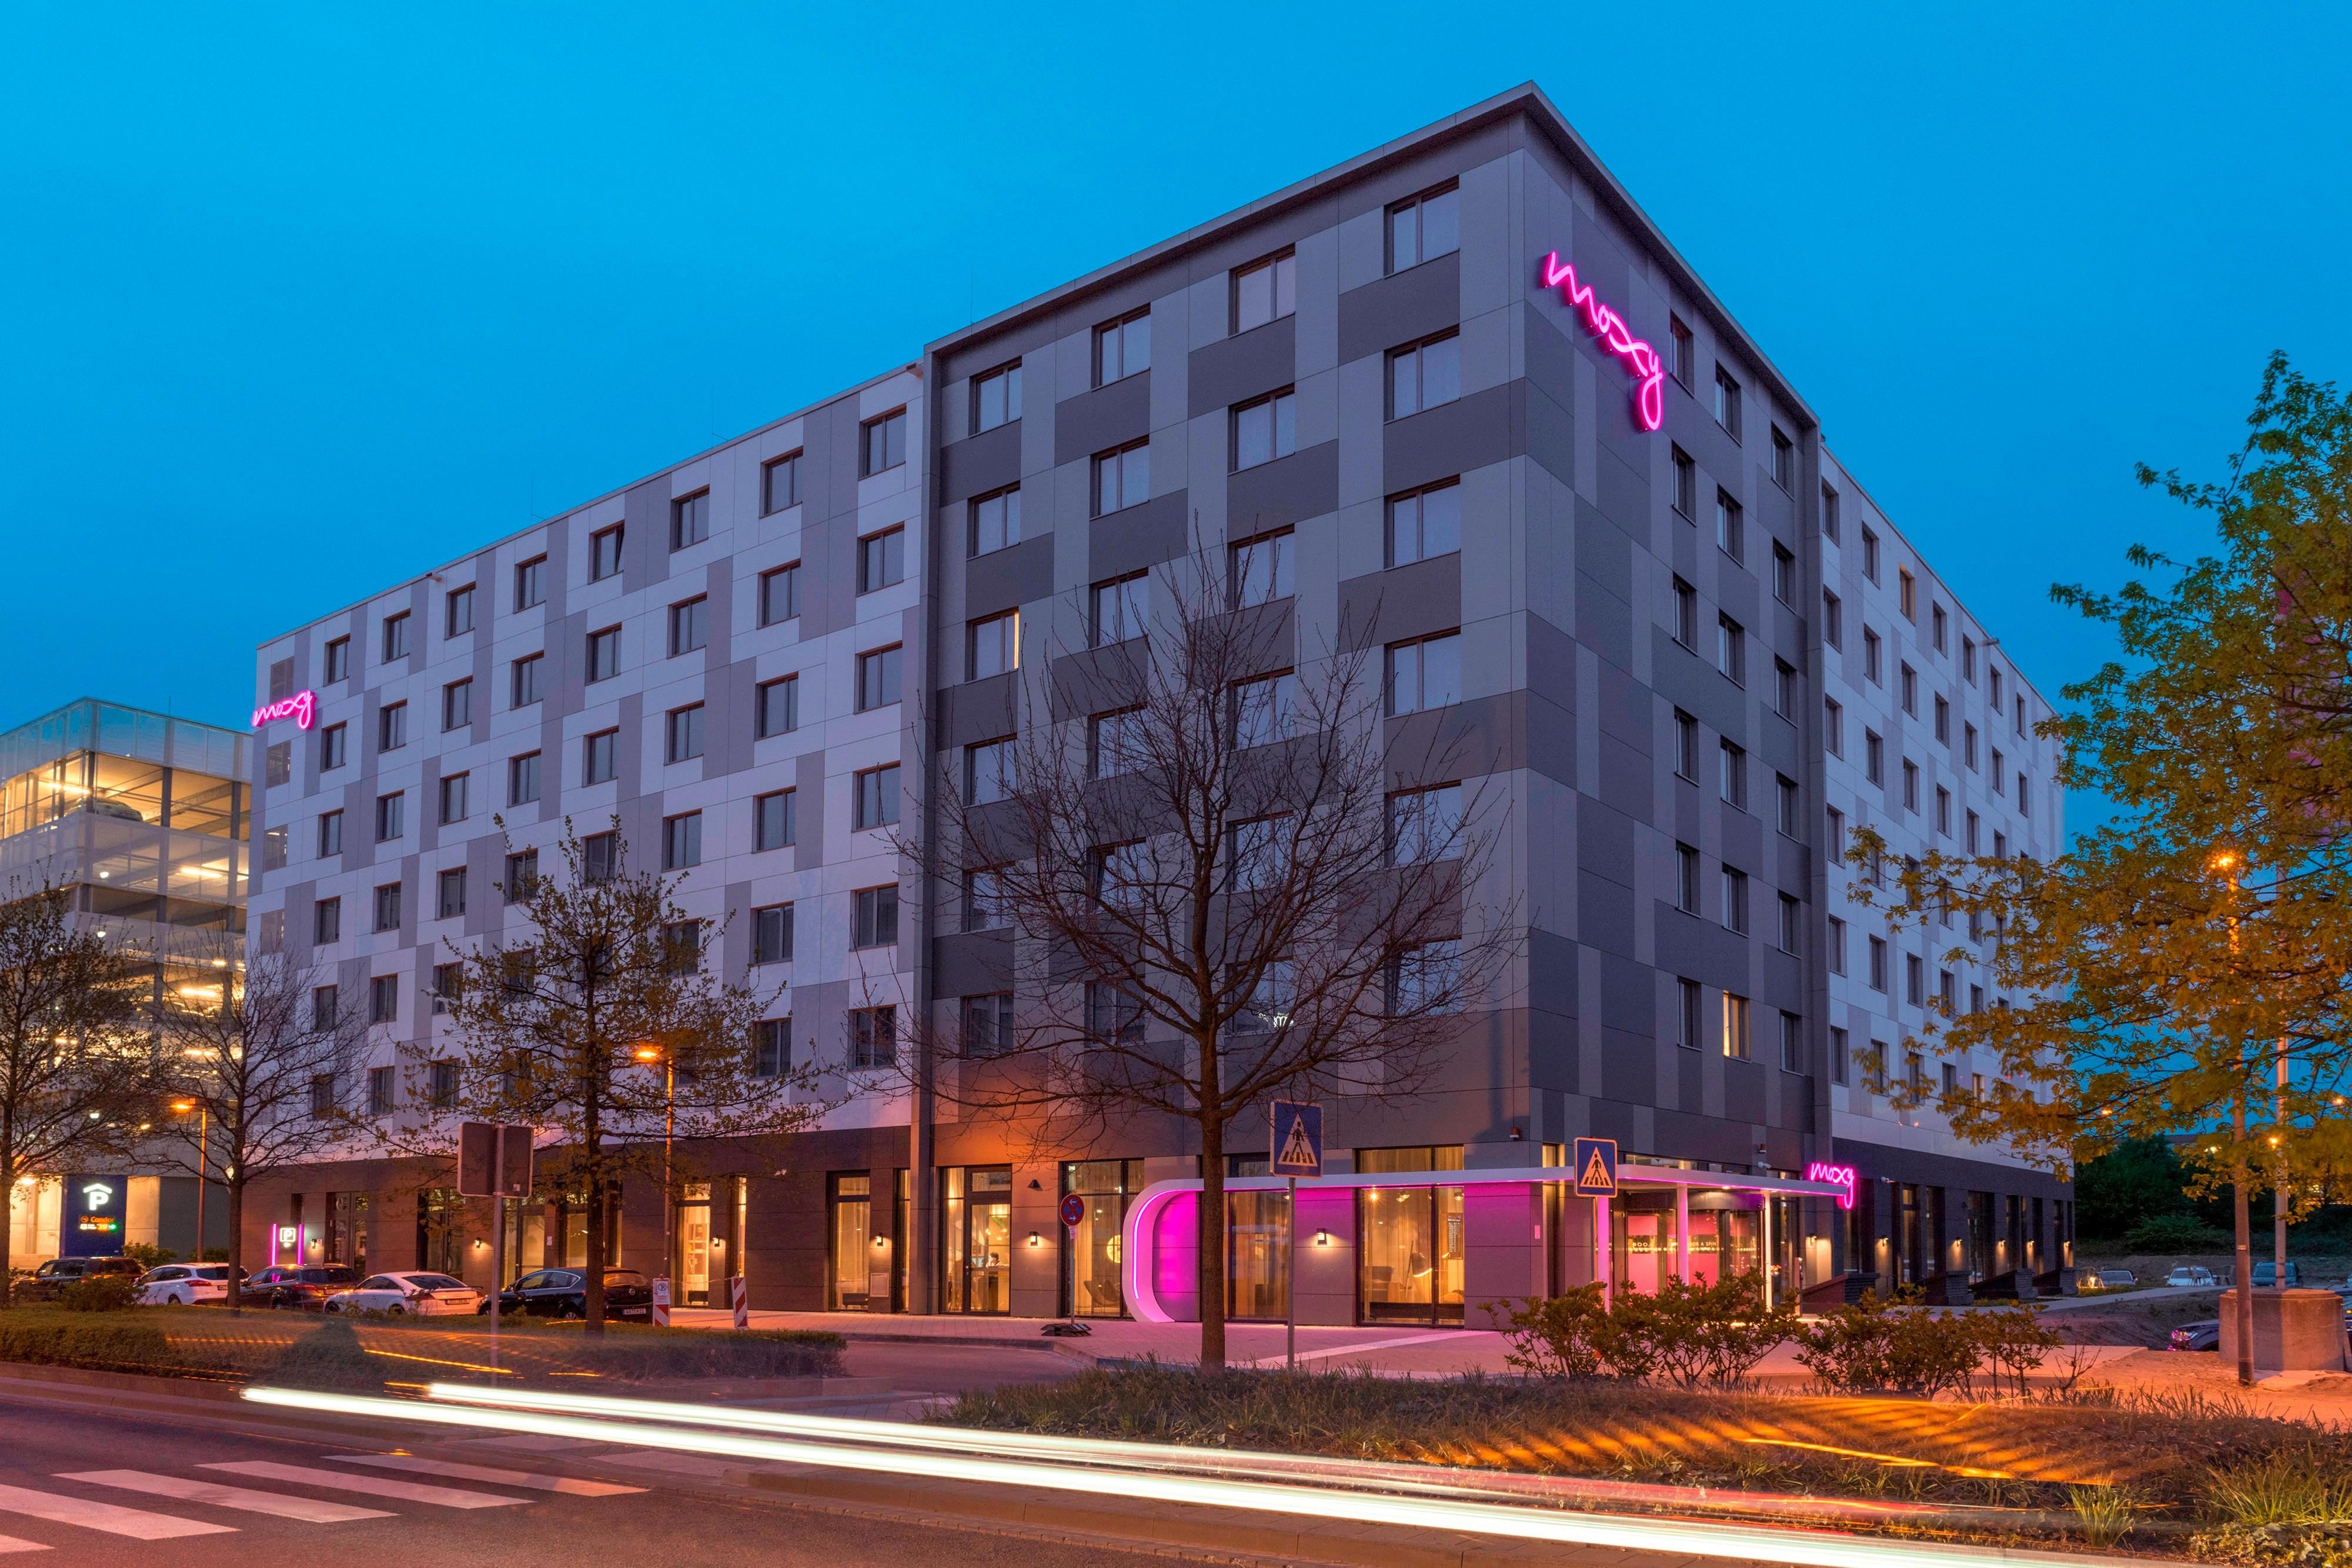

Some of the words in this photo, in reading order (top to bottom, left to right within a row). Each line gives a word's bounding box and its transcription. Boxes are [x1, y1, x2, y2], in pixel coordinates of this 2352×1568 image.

[1539, 249, 1665, 432] moxy
[253, 690, 316, 730] moxy
[89, 1191, 109, 1210] P
[1810, 1163, 1855, 1209] moxy
[283, 1230, 292, 1240] P
